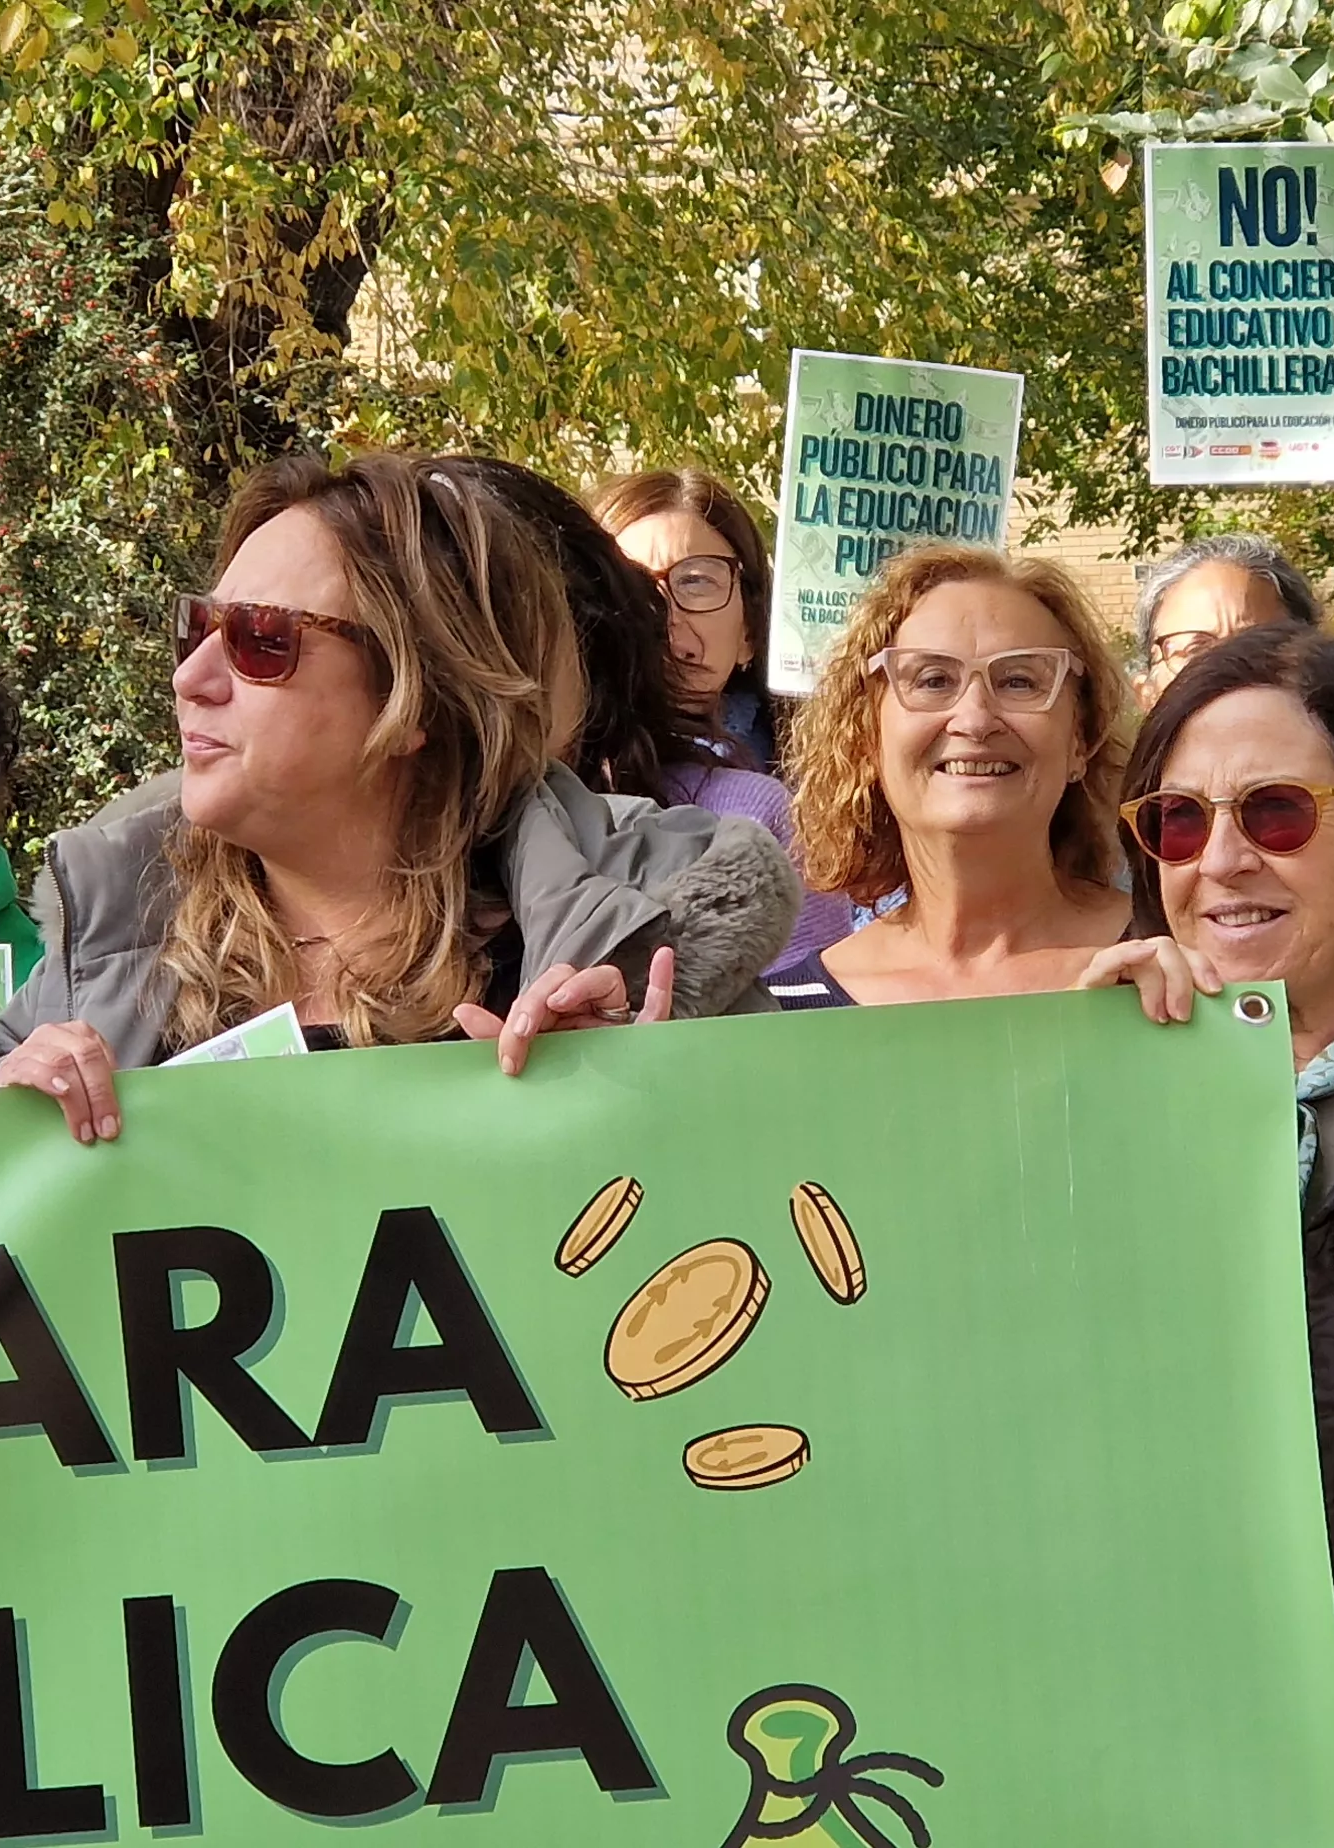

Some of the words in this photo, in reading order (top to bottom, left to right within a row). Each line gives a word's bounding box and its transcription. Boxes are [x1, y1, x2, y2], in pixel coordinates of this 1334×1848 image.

[1218, 165, 1318, 248] NO!
[1167, 260, 1201, 301] AL
[1168, 307, 1333, 349] EDUCATIVO
[854, 391, 963, 443] DINERO
[1247, 415, 1268, 428] PARA
[1270, 415, 1281, 428] LA
[799, 428, 928, 489] PÚBLICO
[933, 448, 1002, 497] PARA
[795, 482, 831, 527] LA
[836, 486, 1000, 540] EDUCACIÓN
[798, 587, 815, 604] NO
[816, 589, 825, 606] A
[826, 590, 847, 607] LOS
[801, 606, 816, 623] EN
